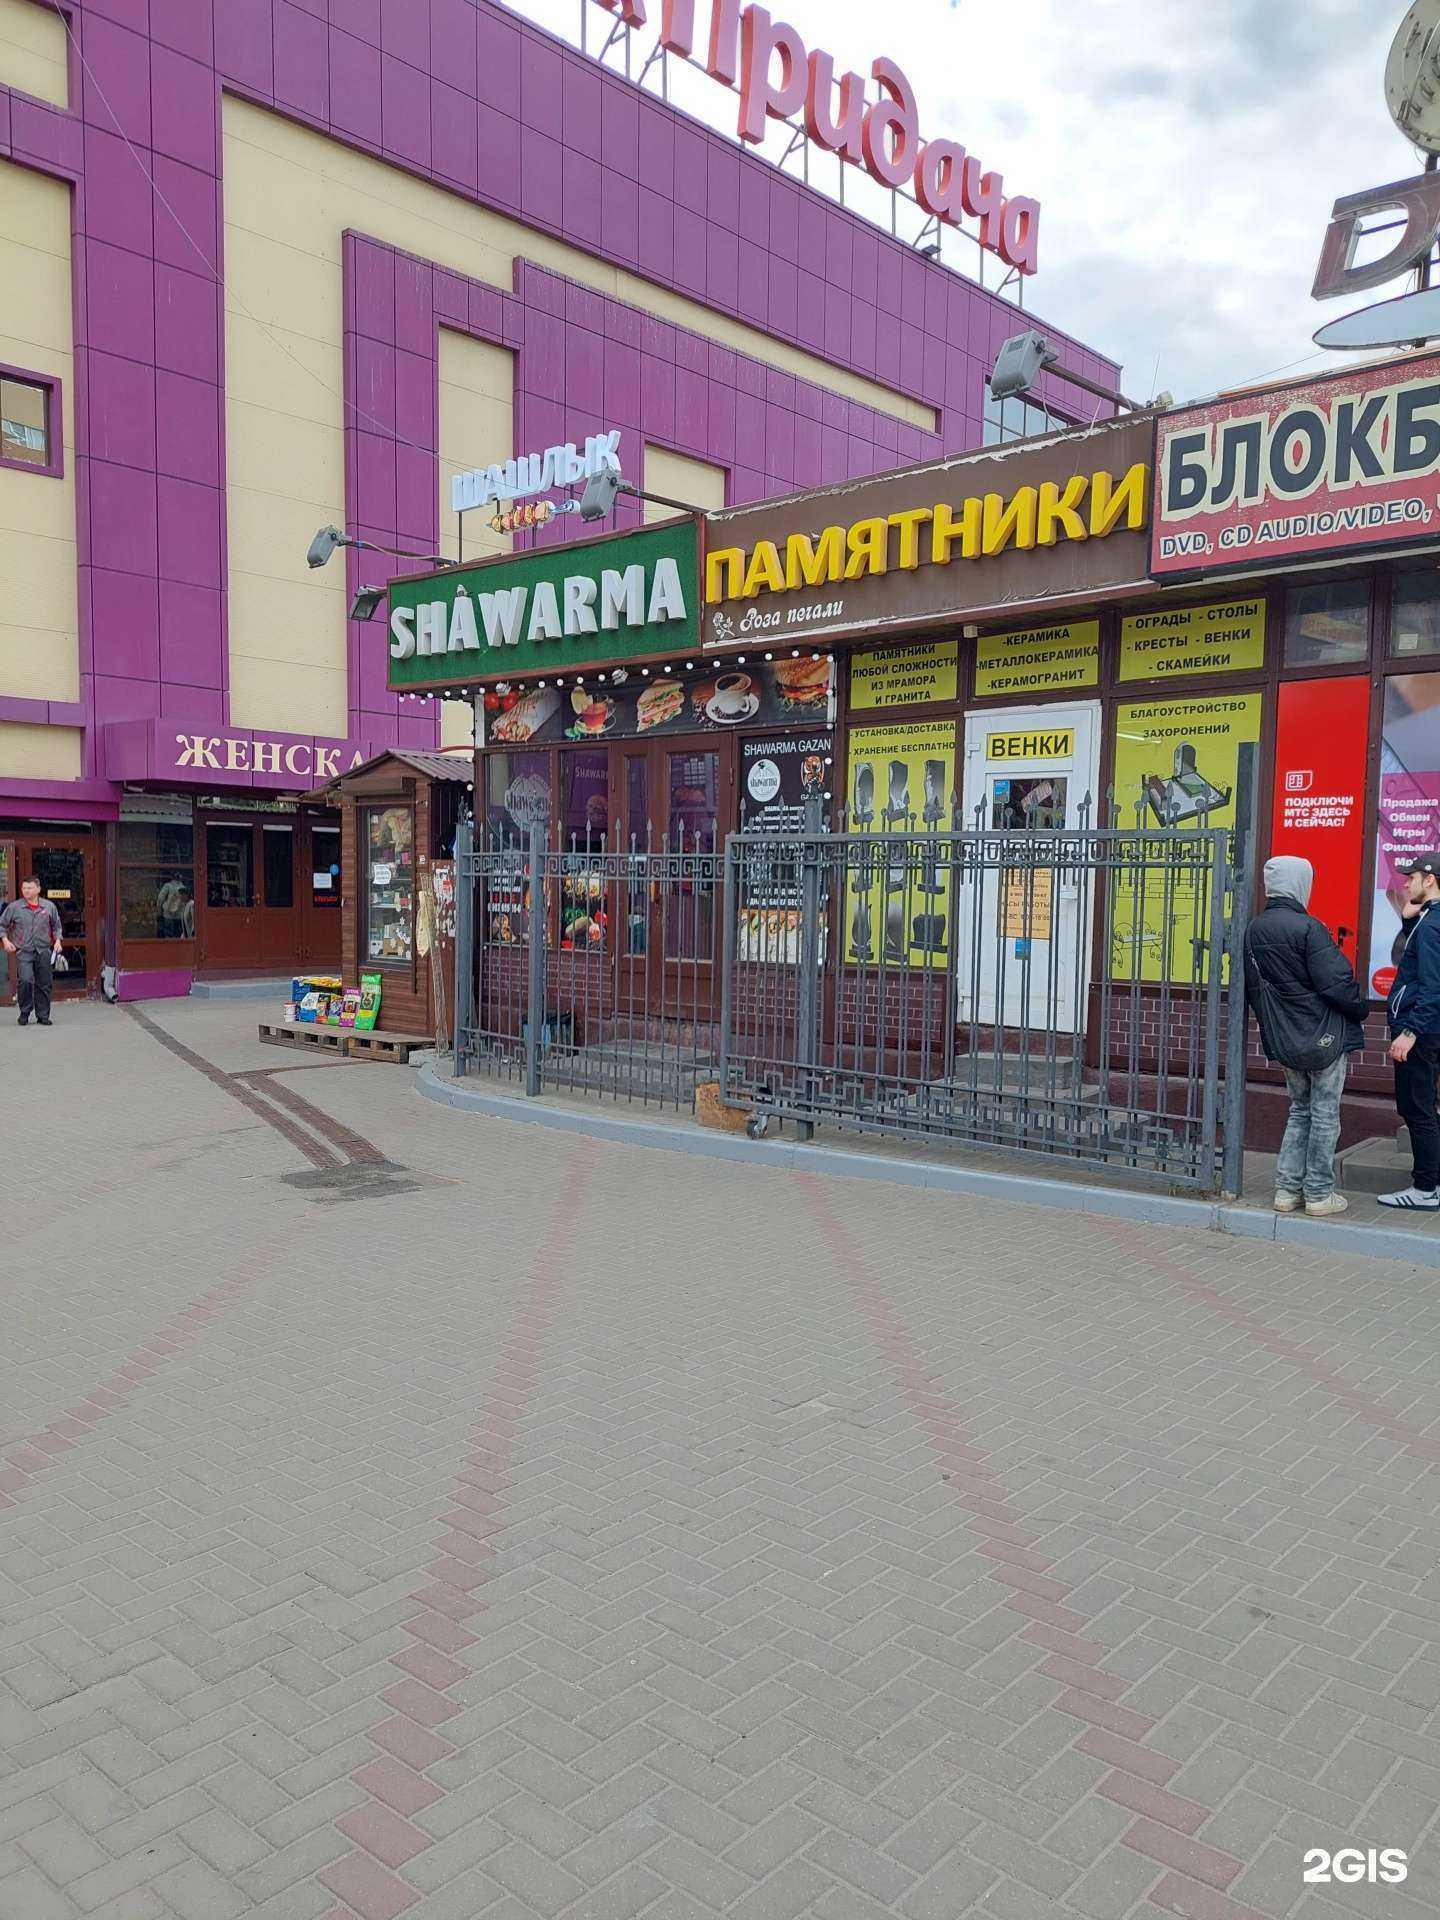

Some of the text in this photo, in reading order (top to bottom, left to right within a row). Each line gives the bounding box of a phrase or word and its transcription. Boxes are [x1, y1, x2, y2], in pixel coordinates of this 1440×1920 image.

[452, 430, 622, 513] ШАШЛЫК
[706, 463, 1149, 603] ПАМЯТНИКИ
[1162, 499, 1431, 556] DVD, CD AUDIO/VIDEO,
[391, 557, 687, 660] SHAWARMA
[1135, 603, 1258, 629] ОГРАДЫ СТОЛЫ
[740, 607, 781, 632] Роза
[1134, 628, 1251, 651] КРЕСТЫ ВЕНКИ
[873, 645, 936, 660] ПАМЯТНИКИ
[852, 657, 958, 678] ЛЮБОЙ СЛОЖНОСТИ
[1156, 654, 1231, 671] СКАМЕЙКИ
[871, 675, 936, 690] ИЗ МРАМОРА
[885, 691, 931, 703] ГРАНИТА
[1130, 701, 1246, 719] БЛАГОУСТРОЙСТВО
[1143, 723, 1230, 738] ЗАХОРОНЕНИЙ
[744, 738, 831, 756] SHAWARMA GAZAN
[854, 741, 956, 755] ХРАНЕНИЕ БЕСПЛАТНО
[991, 734, 1069, 758] ВЕНКИ
[1285, 796, 1354, 807] ПОДКЛЮЧИ
[1382, 798, 1438, 808] Продажа
[1284, 807, 1351, 817] МТС ЗДЕСЬ
[1389, 813, 1430, 822] Обмен
[1284, 817, 1345, 827] И СЕЙЧАС!
[1393, 828, 1426, 838] Игры
[1382, 843, 1435, 852] Фильмы
